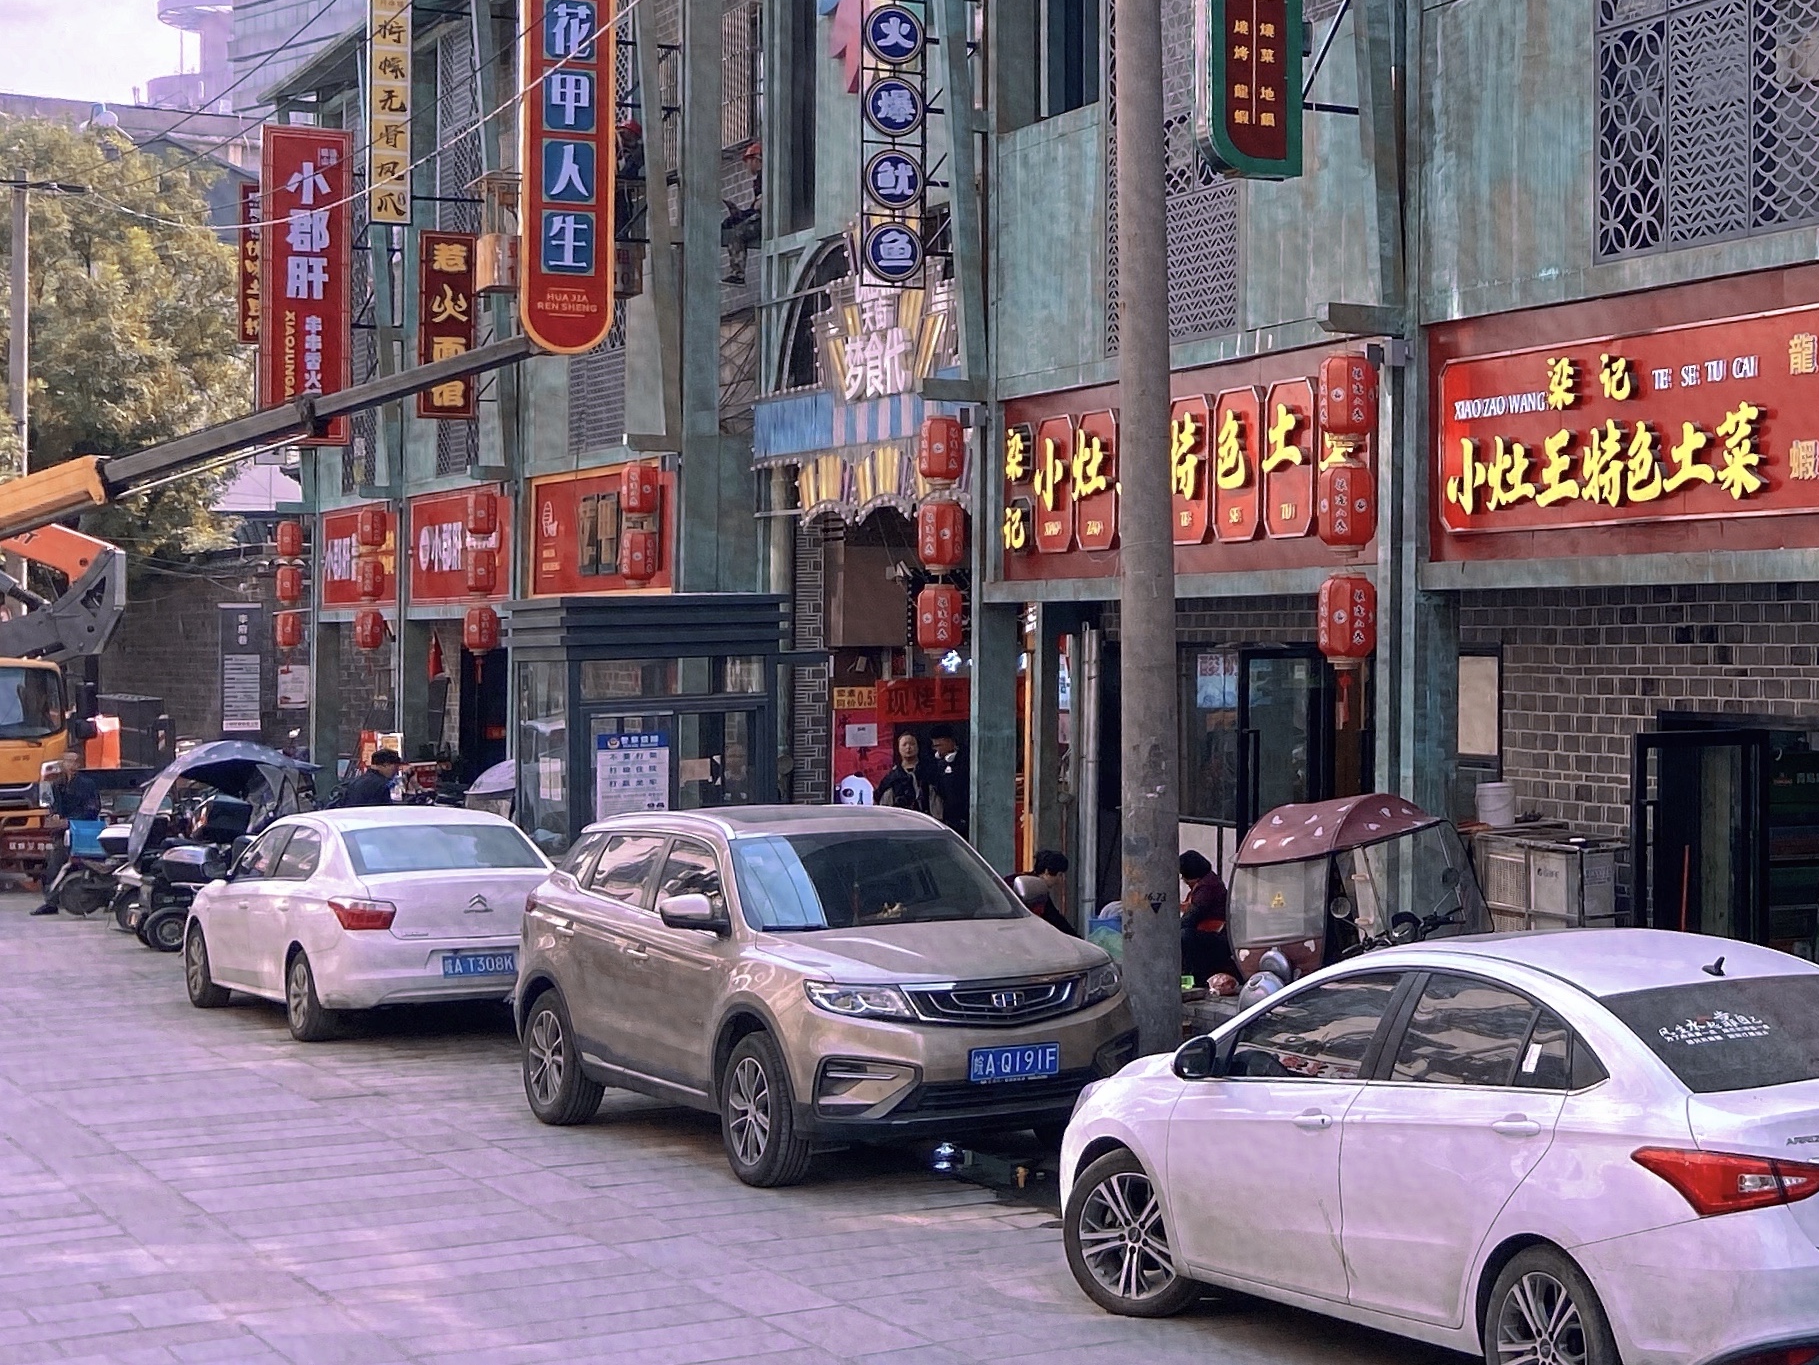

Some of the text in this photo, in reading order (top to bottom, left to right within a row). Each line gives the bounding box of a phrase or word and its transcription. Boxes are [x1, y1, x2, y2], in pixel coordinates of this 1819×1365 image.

[548, 2, 591, 268] 花甲人生
[876, 15, 916, 267] 火爆鱿鱼
[285, 161, 332, 300] 小郡肝
[432, 242, 468, 407] 惹火面馆
[537, 301, 598, 314] REN SHENG
[546, 292, 589, 304] HUA JIA
[304, 314, 323, 395] 串串香火
[1547, 354, 1631, 410] 梁记
[1652, 355, 1759, 391] TE SE TU CAI
[1454, 391, 1548, 421] XIAO ZAO WANG
[1004, 428, 1025, 550] 梁记
[1034, 403, 1353, 512] 小灶特色土
[1447, 401, 1762, 515] 小灶王特色土菜
[1229, 507, 1242, 524] SE
[1280, 503, 1296, 520] TU
